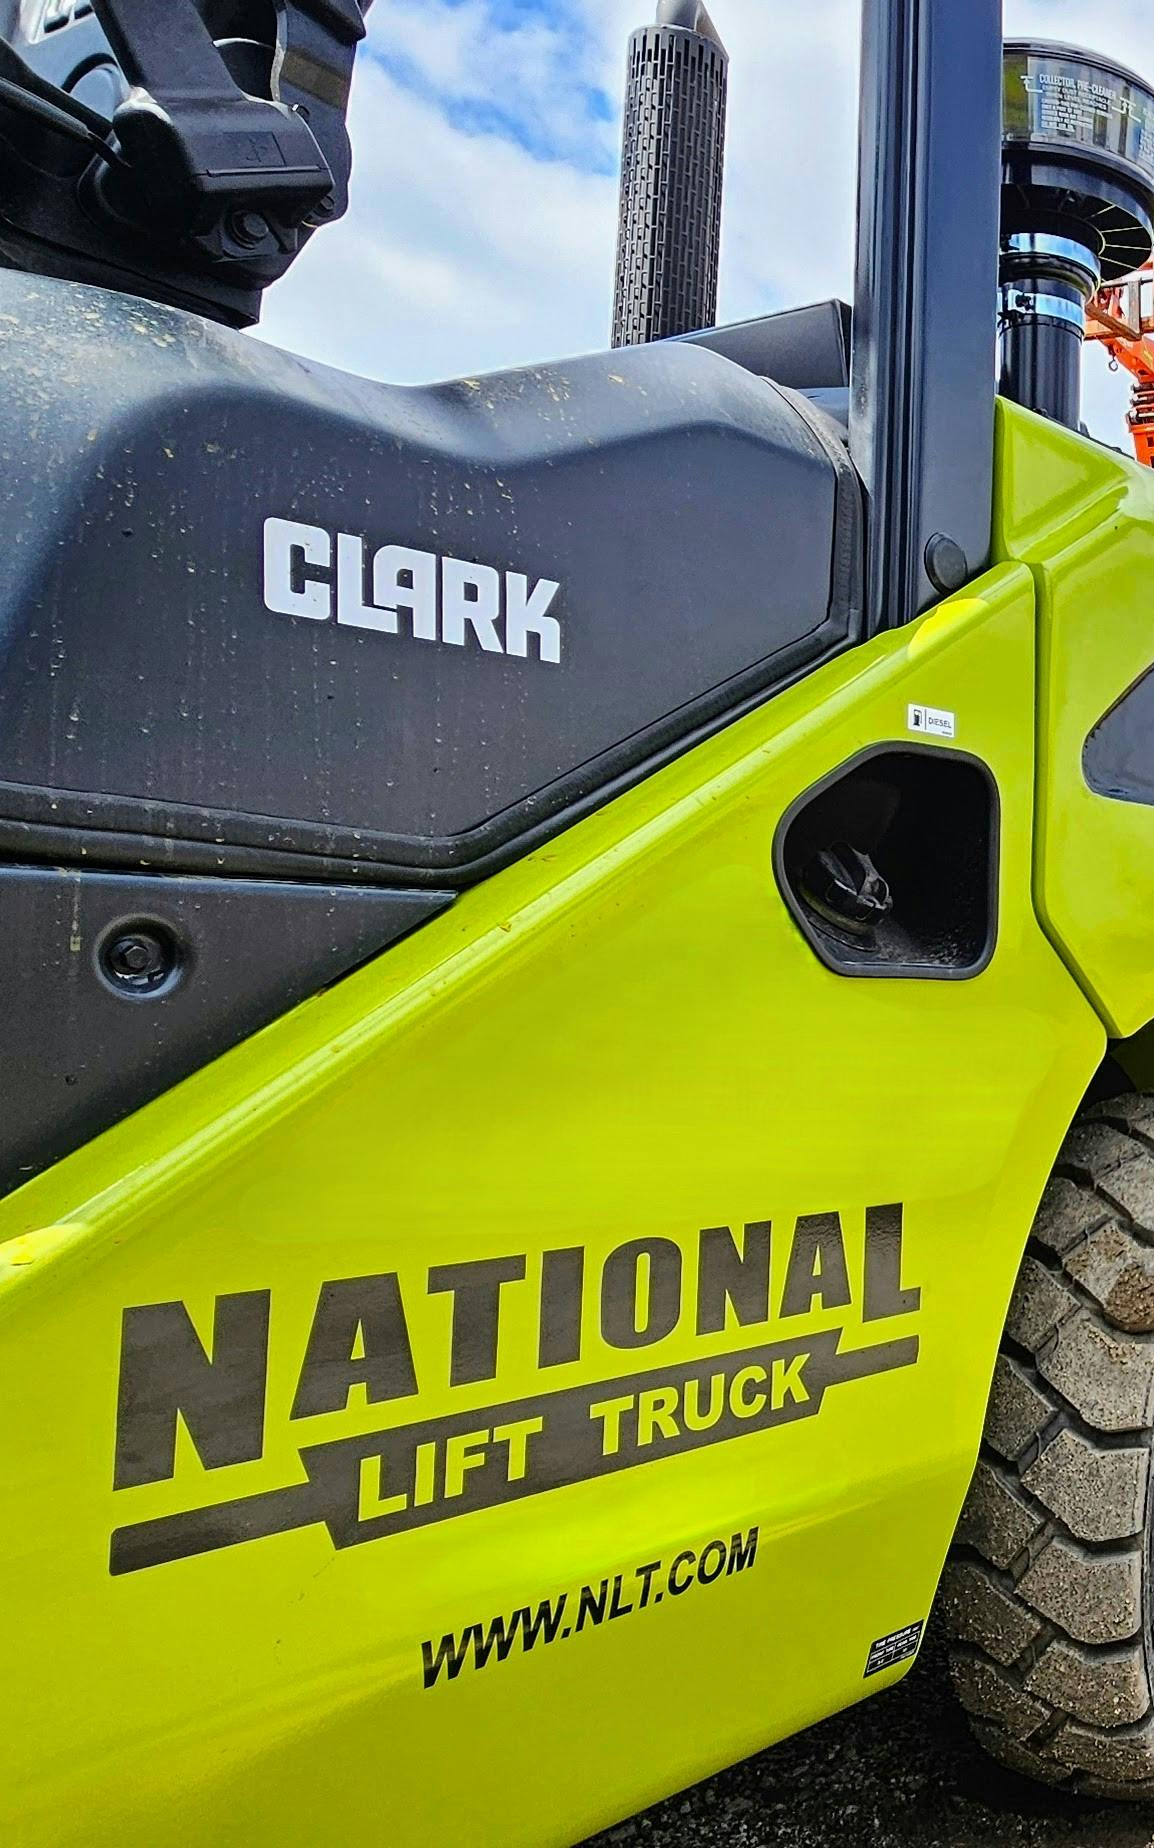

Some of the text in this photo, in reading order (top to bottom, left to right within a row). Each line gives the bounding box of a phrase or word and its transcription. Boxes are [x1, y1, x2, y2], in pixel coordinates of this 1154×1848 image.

[263, 516, 561, 664] CLARK
[928, 717, 952, 729] DIESEL
[113, 1202, 922, 1492] NATIONAL
[357, 1352, 811, 1522] LIFT TRUCK
[420, 1526, 760, 1690] WWW.NLT.COM
